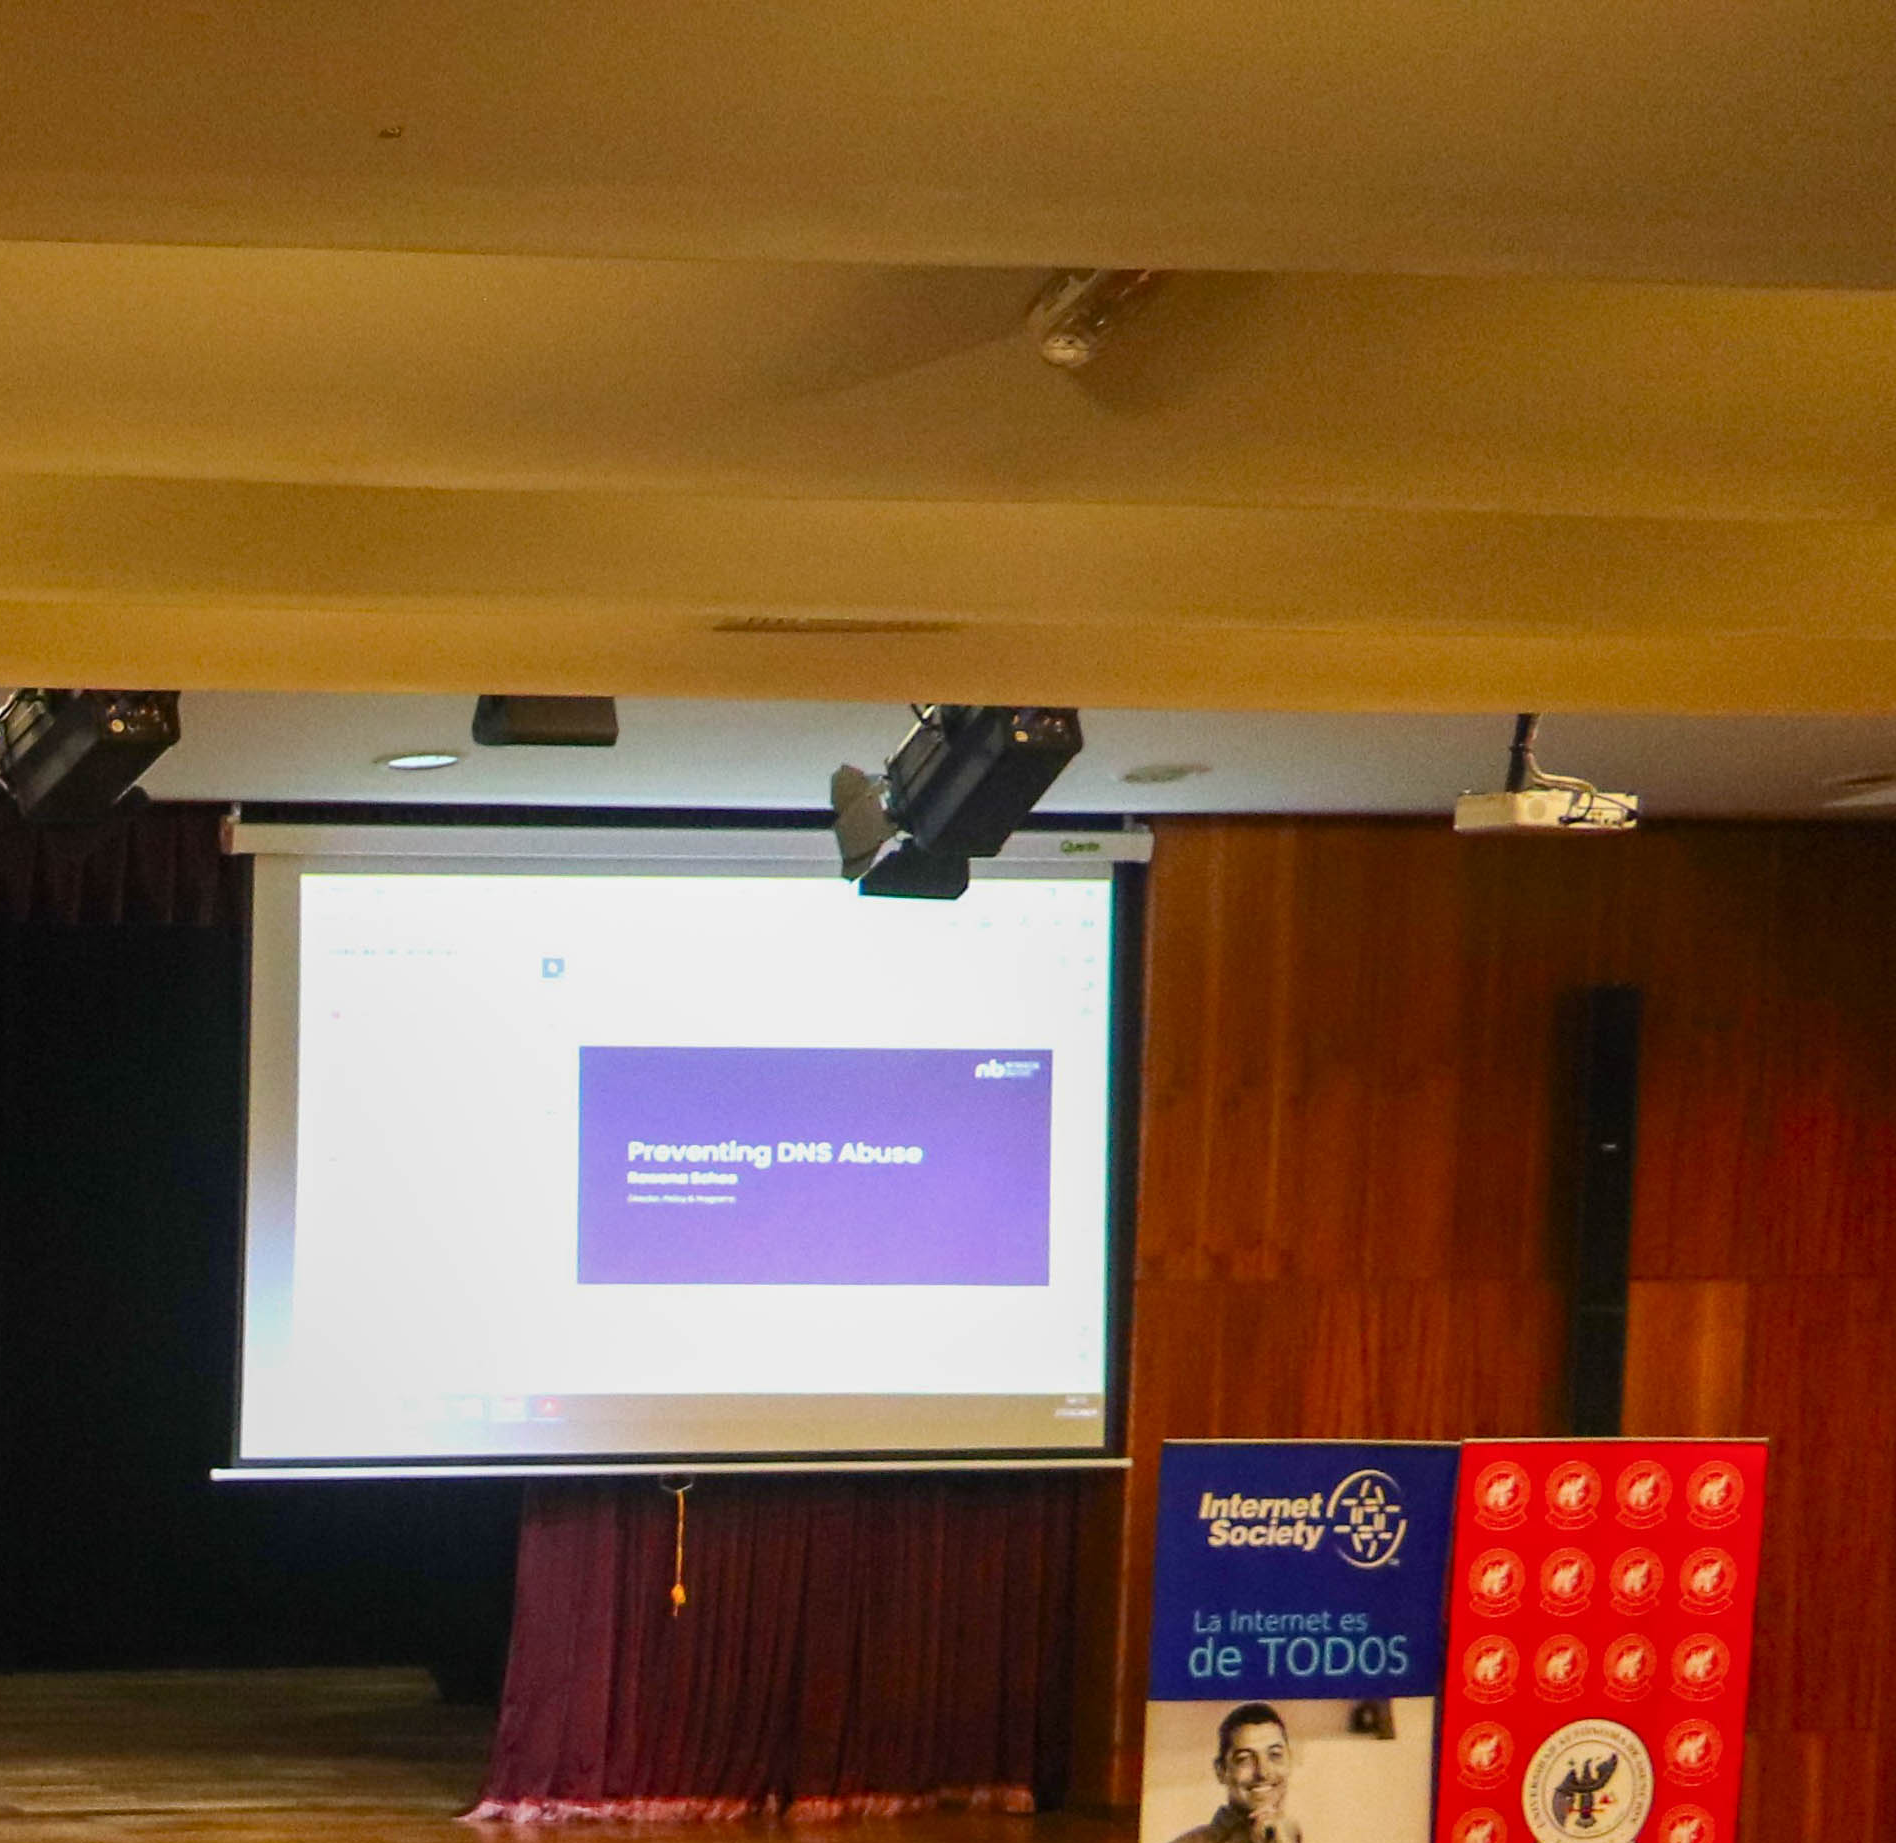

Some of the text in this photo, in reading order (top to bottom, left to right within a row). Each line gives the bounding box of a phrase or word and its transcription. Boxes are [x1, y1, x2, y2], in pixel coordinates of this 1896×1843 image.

[627, 1140, 924, 1170] Preventing DNS Abuse
[1198, 1491, 1325, 1520] Internet
[1207, 1518, 1326, 1552] Society
[1193, 1608, 1370, 1634] La Internet es
[1187, 1633, 1409, 1678] de TODOS
